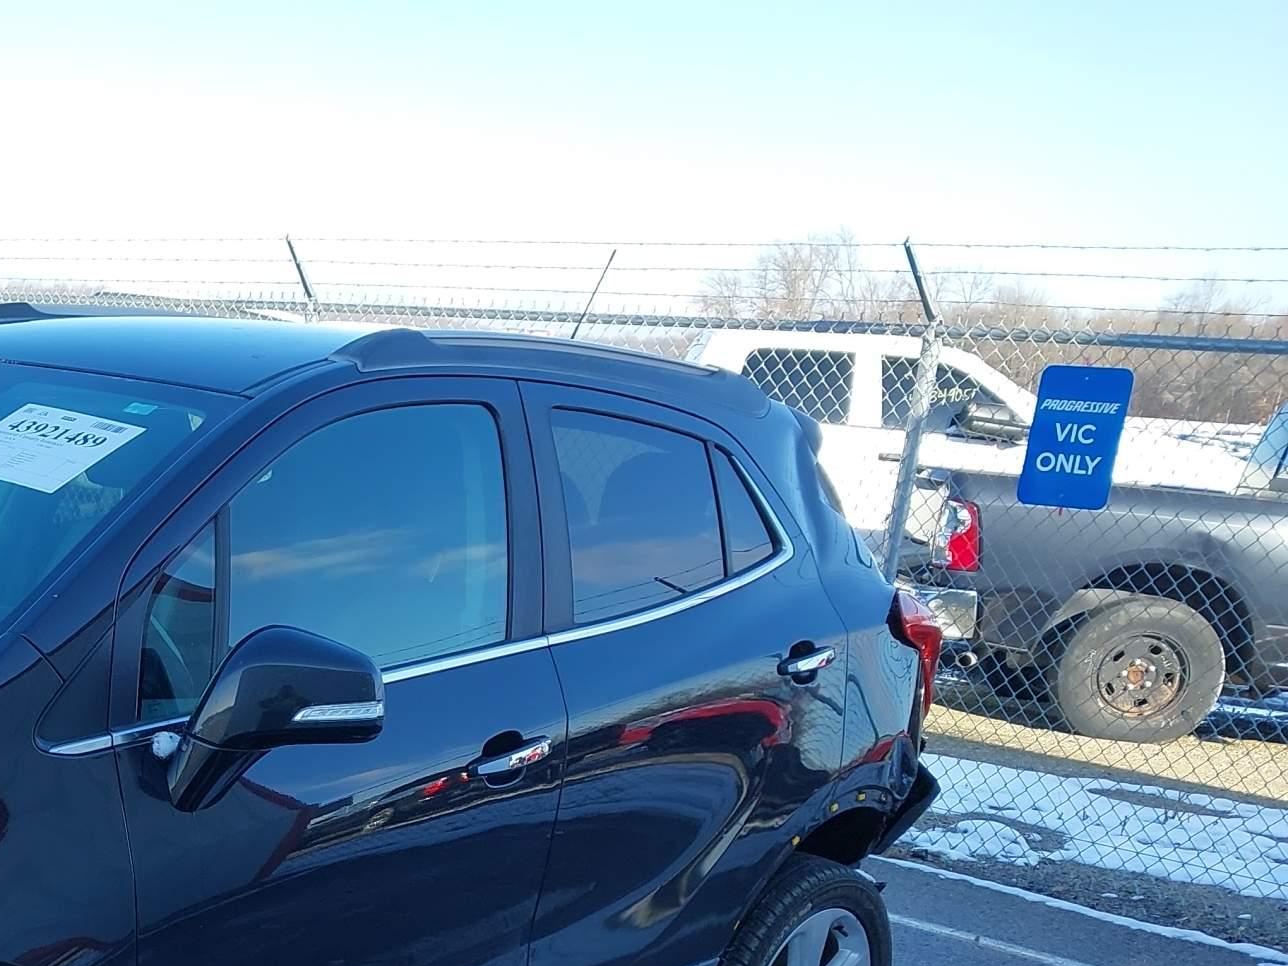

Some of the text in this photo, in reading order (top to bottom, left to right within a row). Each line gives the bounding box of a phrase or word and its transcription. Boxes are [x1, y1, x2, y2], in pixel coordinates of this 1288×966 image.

[1040, 399, 1122, 414] PROGRESSIVE
[8, 418, 108, 448] 43921489
[1055, 422, 1097, 444] VIC
[1036, 452, 1102, 475] ONLY
